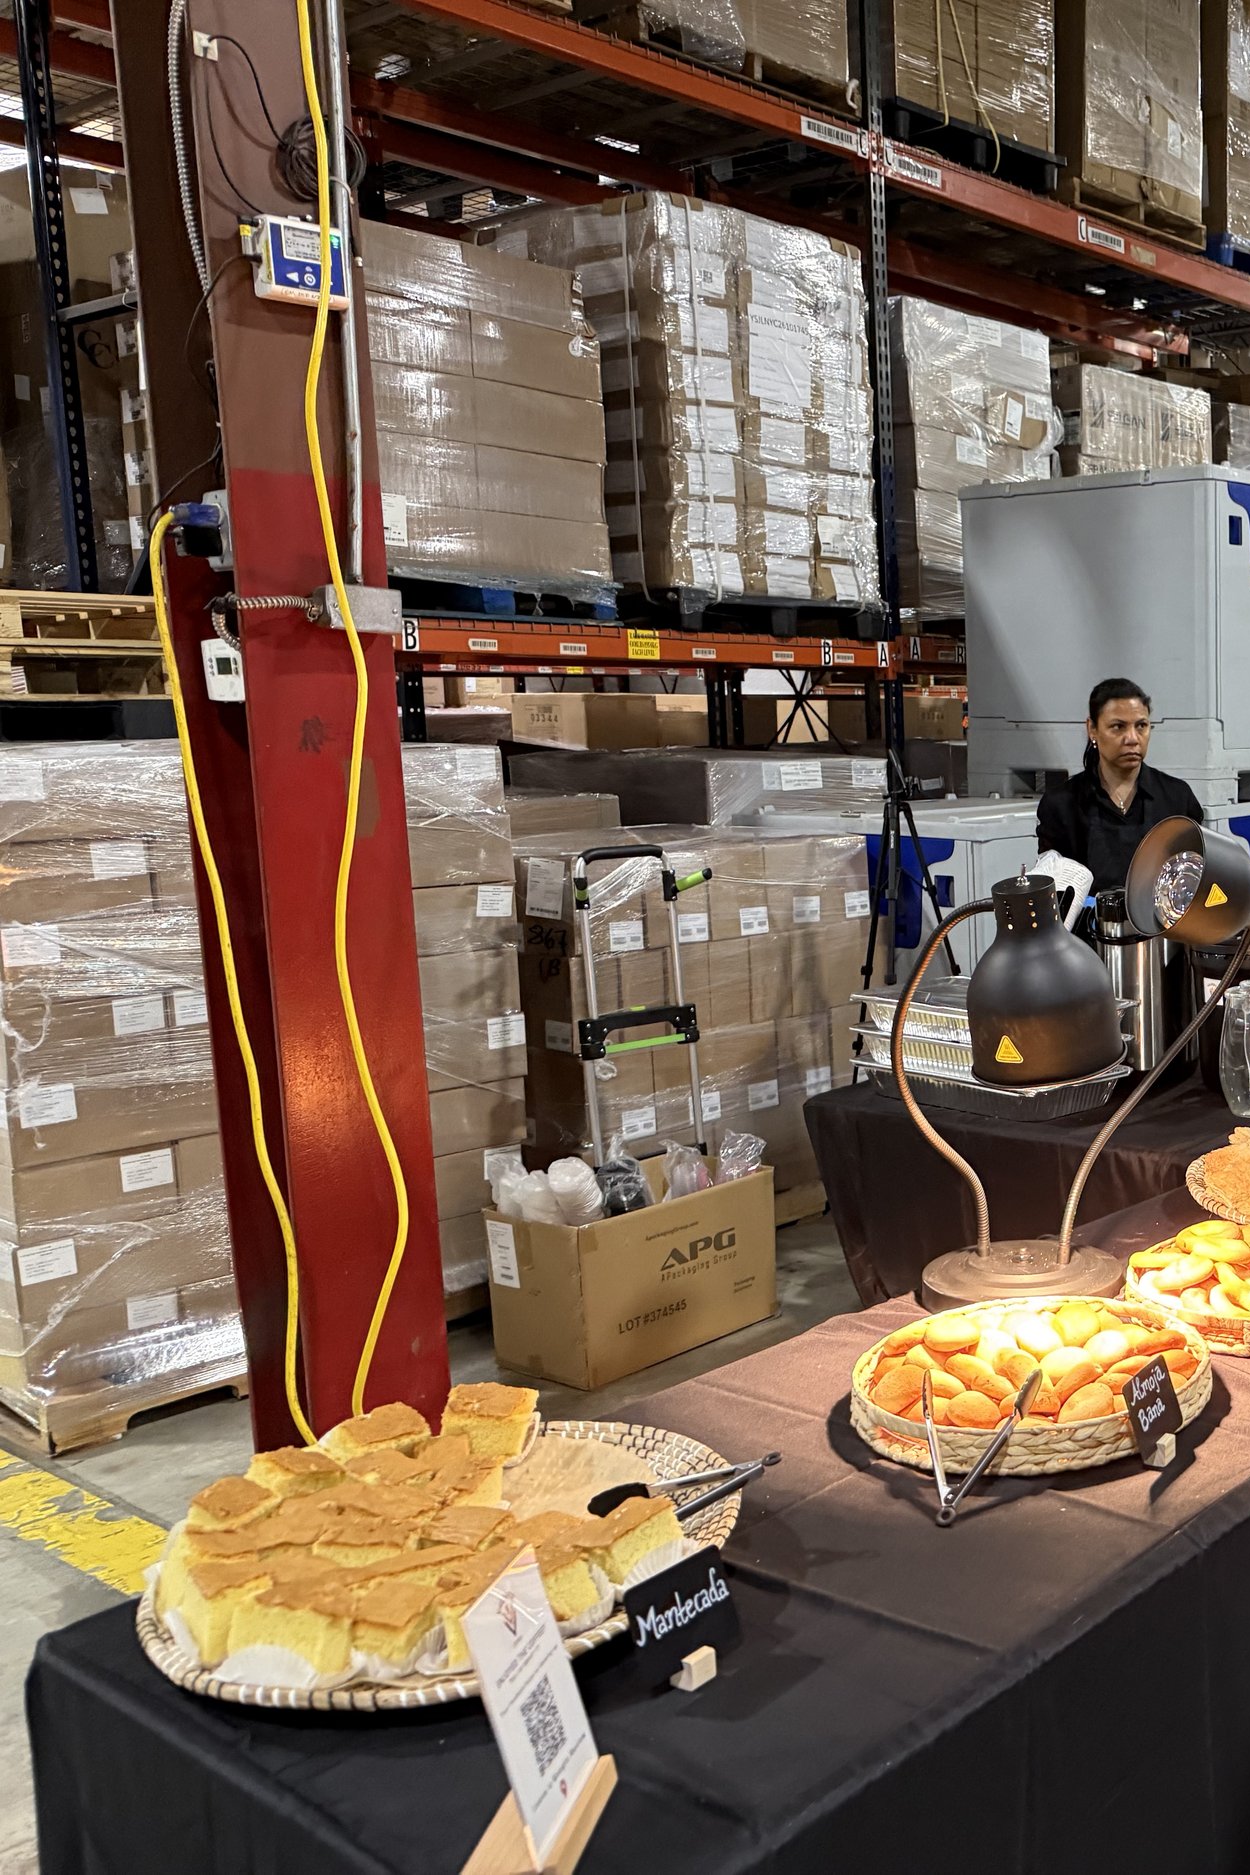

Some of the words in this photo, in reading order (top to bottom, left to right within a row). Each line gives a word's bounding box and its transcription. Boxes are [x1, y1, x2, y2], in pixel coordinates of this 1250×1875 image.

[404, 620, 417, 649] B
[912, 637, 921, 660] A
[823, 640, 831, 666] B
[880, 643, 888, 667] A
[660, 1227, 736, 1272] APG
[713, 1250, 738, 1264] Group
[1130, 1365, 1166, 1407] Almoja
[1137, 1397, 1167, 1432] Bana
[636, 1567, 730, 1647] Mantecada
